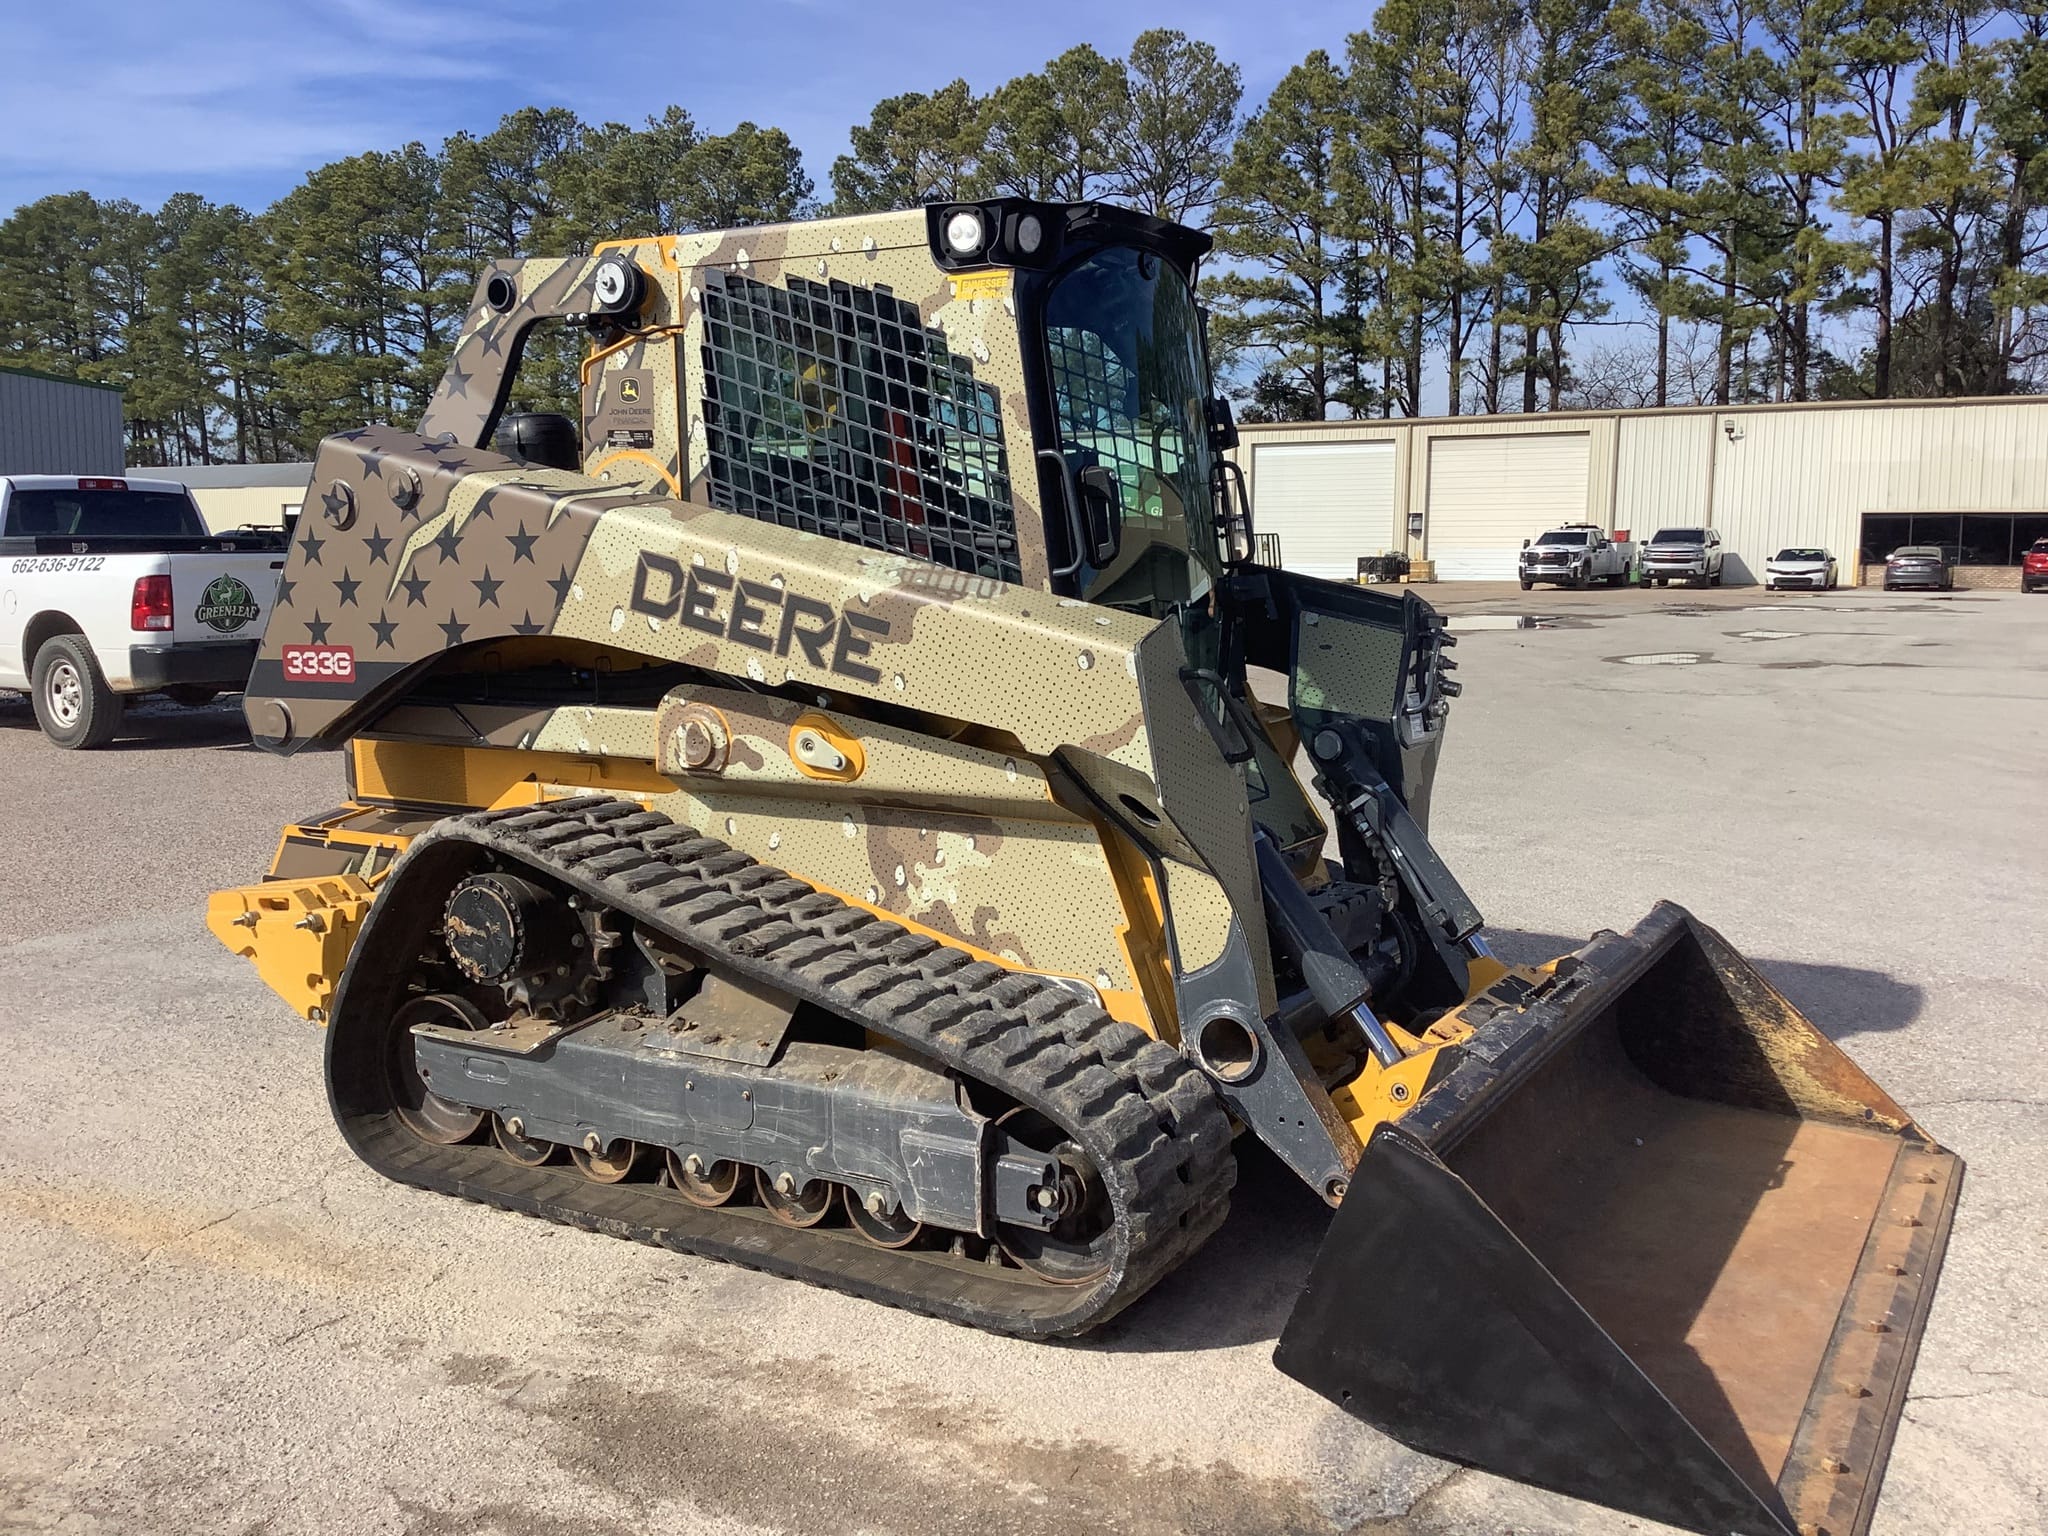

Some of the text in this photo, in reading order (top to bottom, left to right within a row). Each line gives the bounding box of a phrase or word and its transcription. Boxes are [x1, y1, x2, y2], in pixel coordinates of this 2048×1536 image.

[609, 407, 652, 416] JOHN DEERE
[12, 556, 106, 574] 662-636-9122
[629, 549, 892, 686] DEERE
[286, 650, 352, 676] 333G
